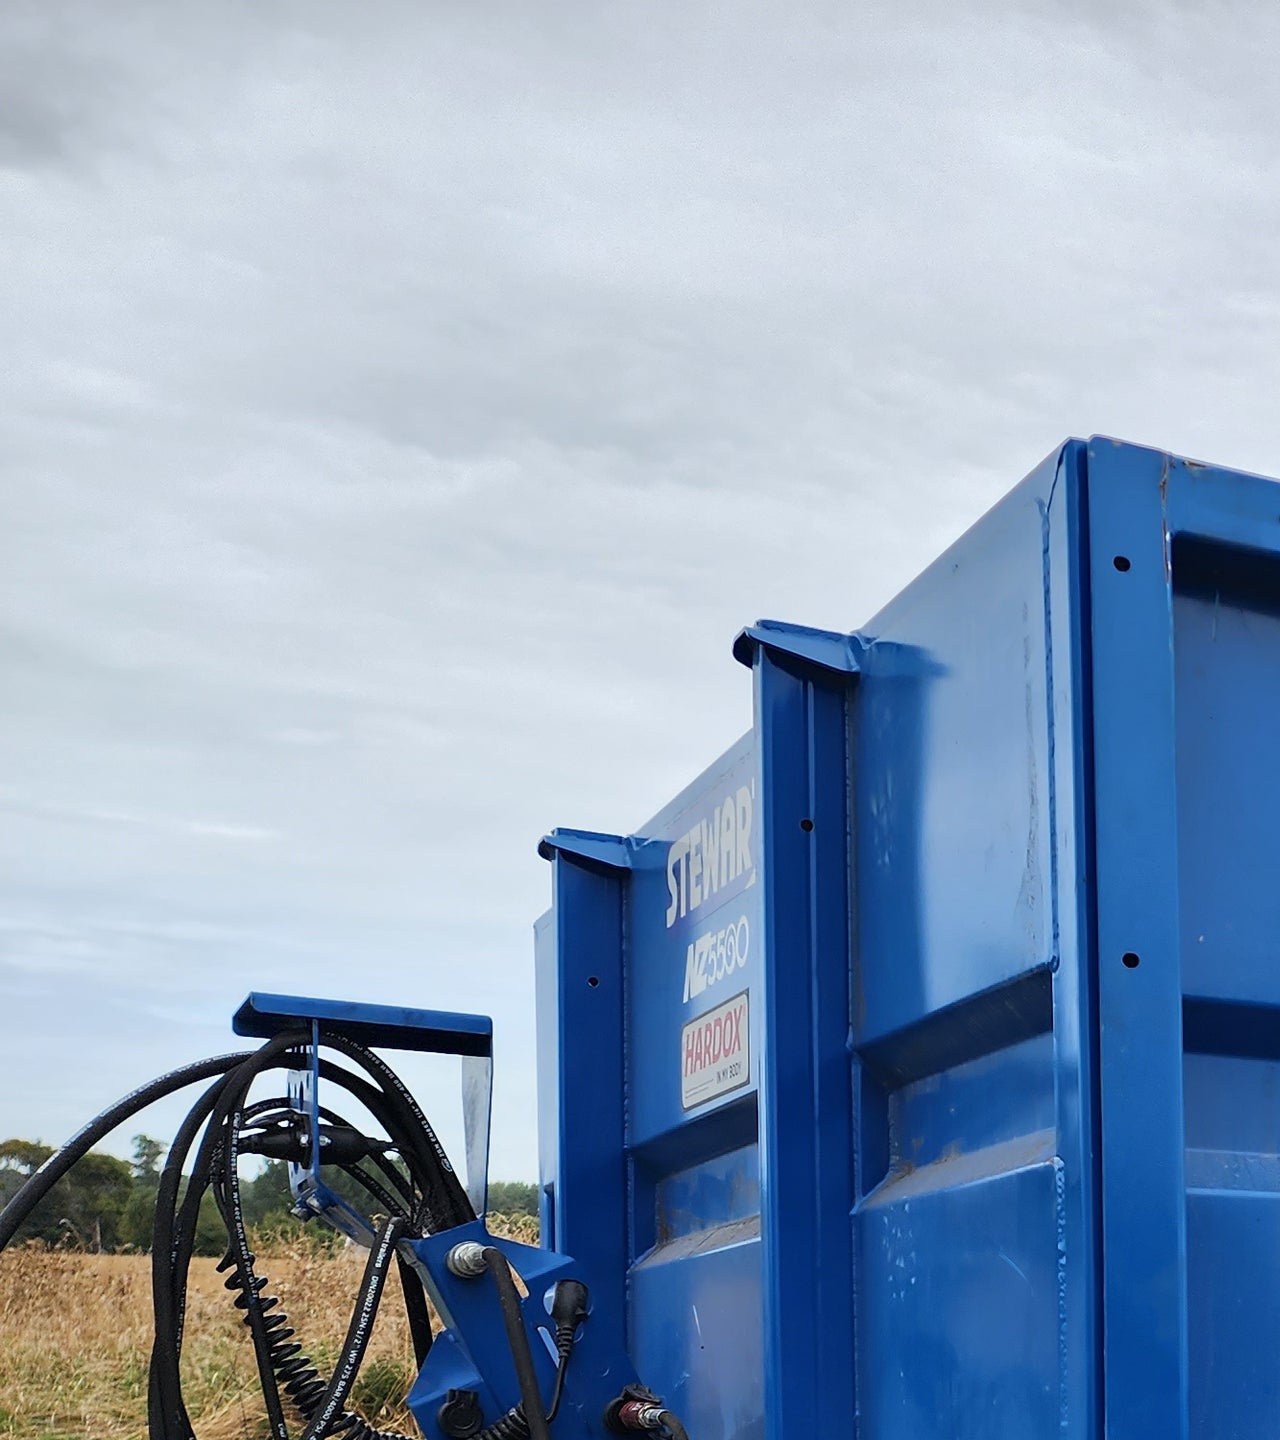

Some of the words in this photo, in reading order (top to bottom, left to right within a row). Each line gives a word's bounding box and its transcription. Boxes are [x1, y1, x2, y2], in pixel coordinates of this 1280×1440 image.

[666, 777, 755, 929] STEWAR
[684, 1004, 743, 1078] HARDOX
[362, 1275, 379, 1312] DIN20022
